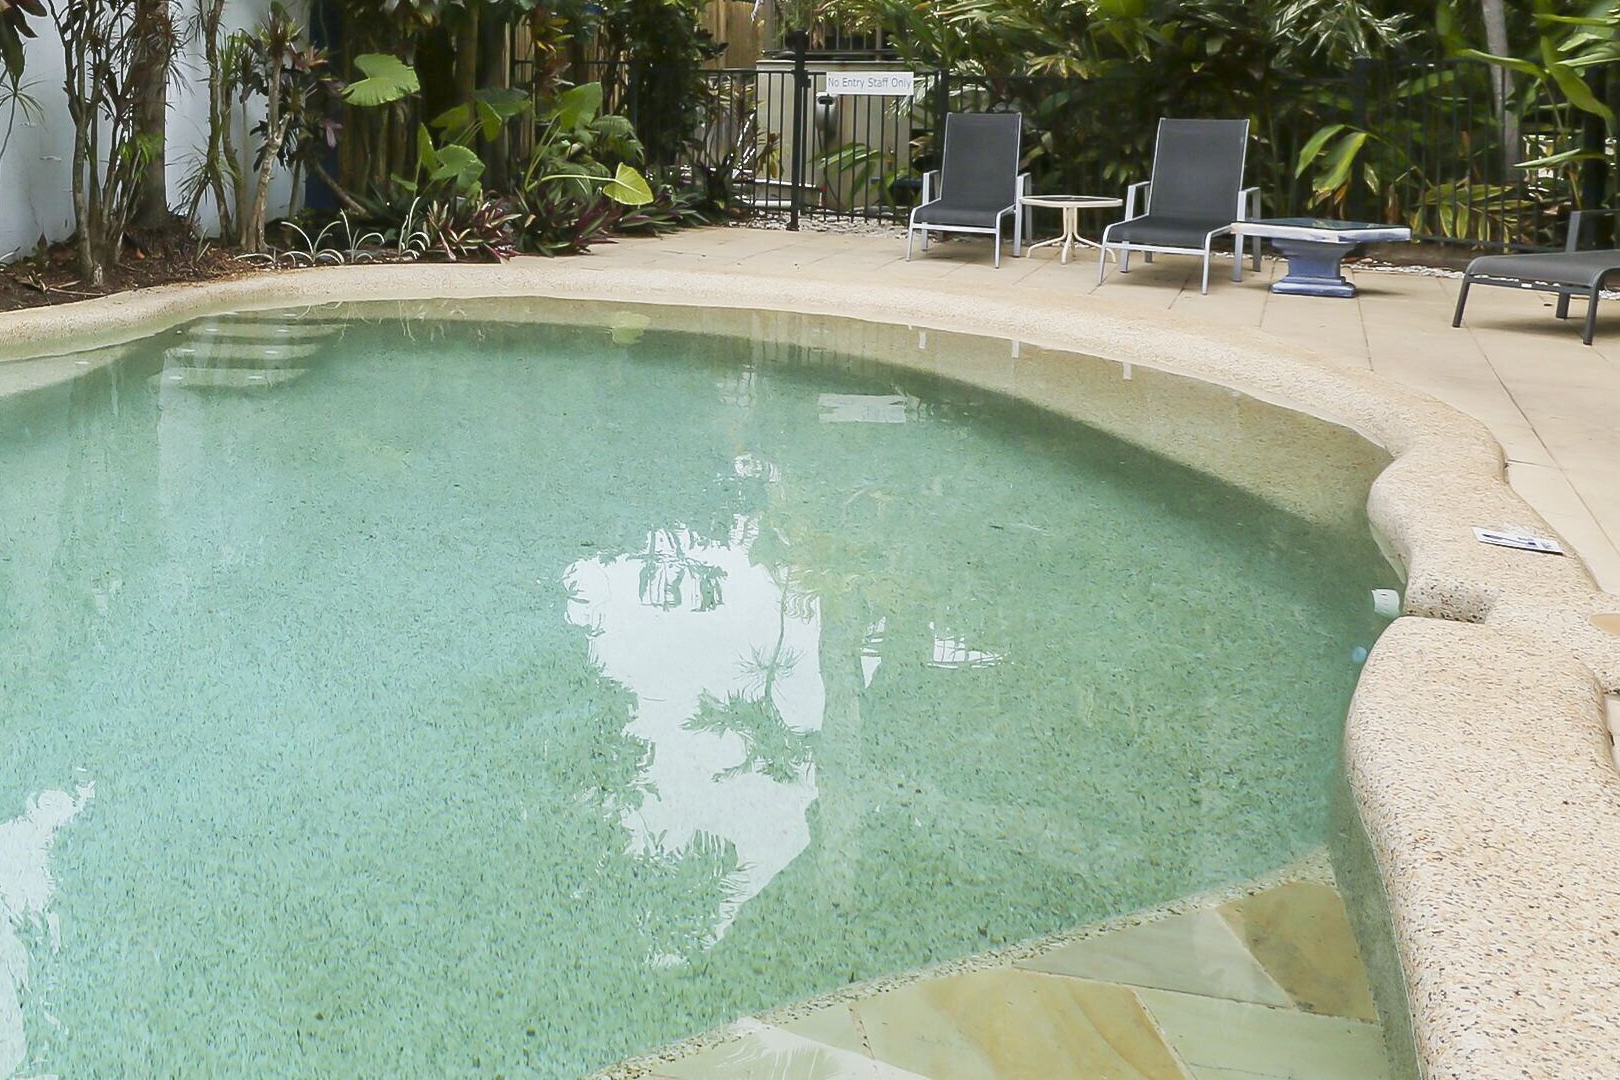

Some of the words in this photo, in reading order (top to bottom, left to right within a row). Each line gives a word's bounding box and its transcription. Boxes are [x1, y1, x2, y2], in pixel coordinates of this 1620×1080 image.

[828, 77, 840, 88] No
[842, 77, 865, 89] Entry
[867, 77, 888, 88] Staff
[891, 77, 912, 89] Only
